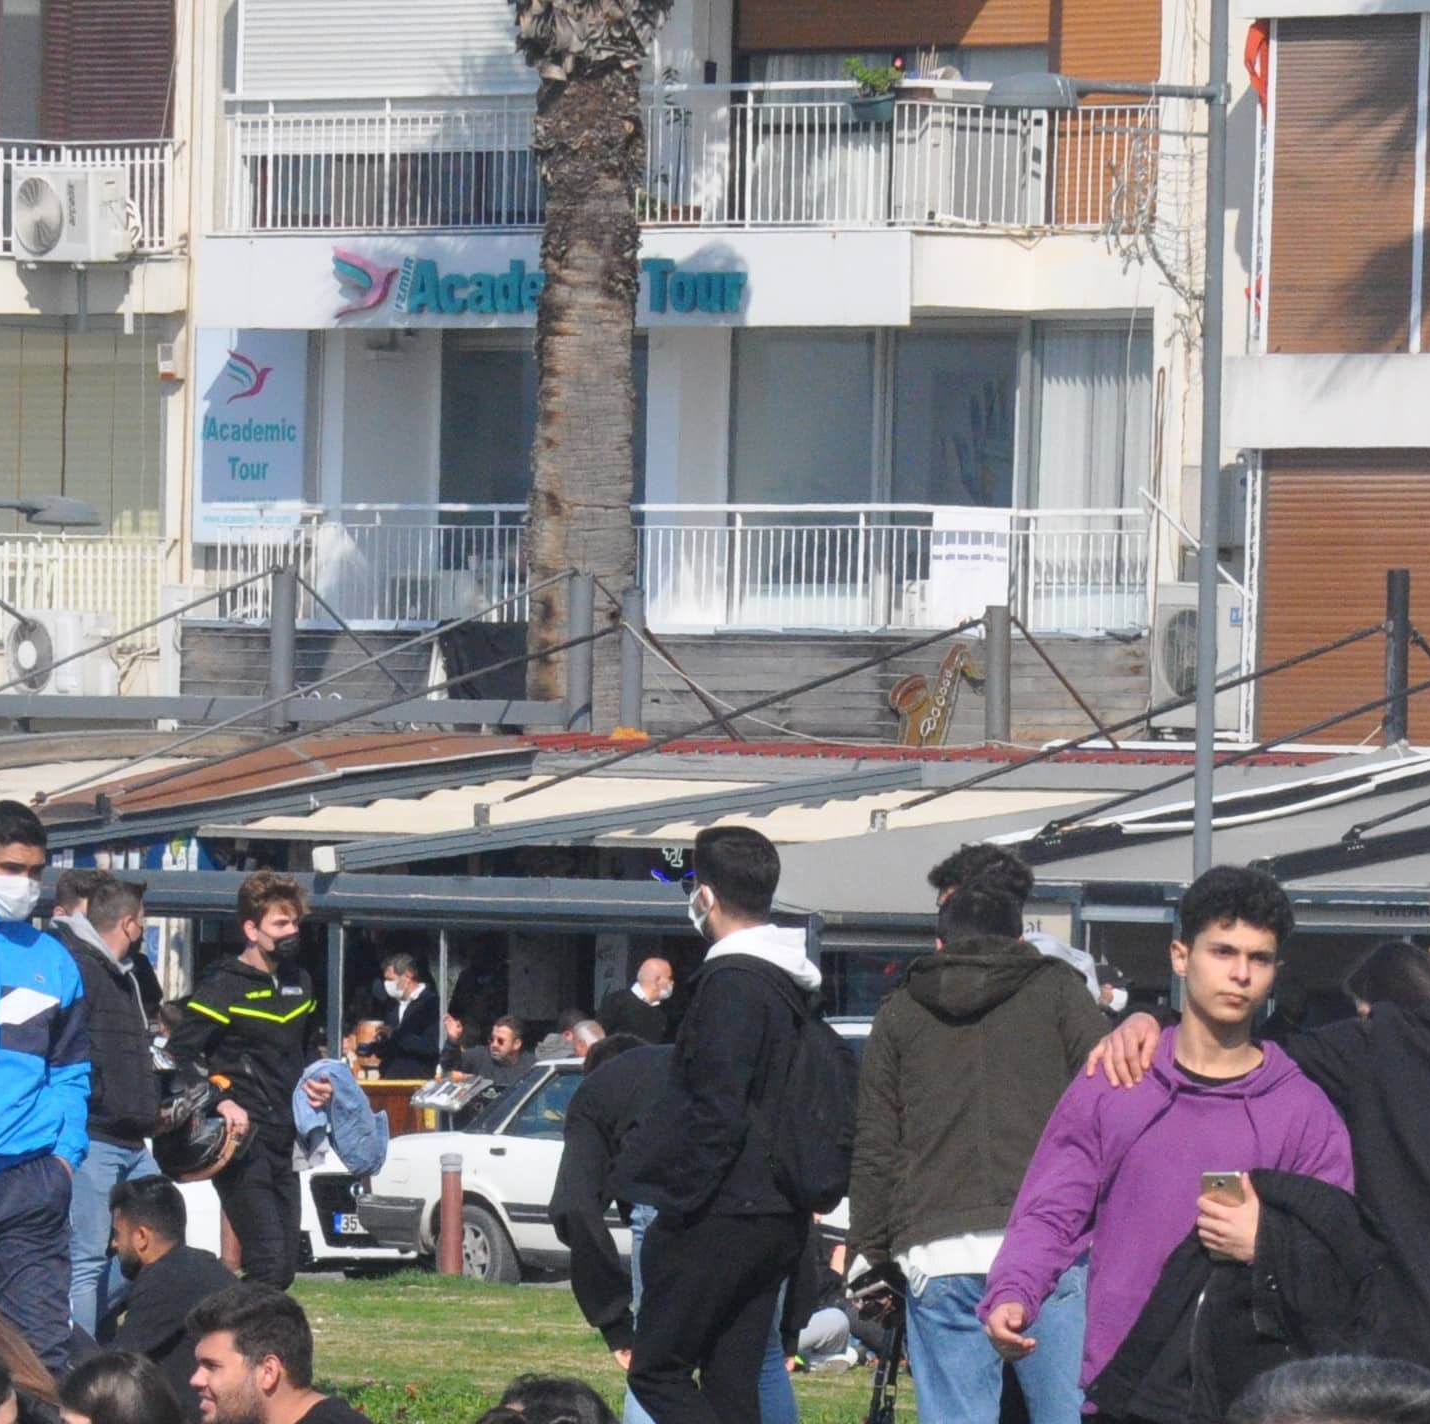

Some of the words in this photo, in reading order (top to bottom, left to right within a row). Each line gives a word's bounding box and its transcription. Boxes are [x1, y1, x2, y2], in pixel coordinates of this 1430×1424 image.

[408, 259, 545, 314] Acade
[641, 258, 748, 314] Tour
[208, 417, 297, 442] Academic
[228, 456, 269, 480] Tour
